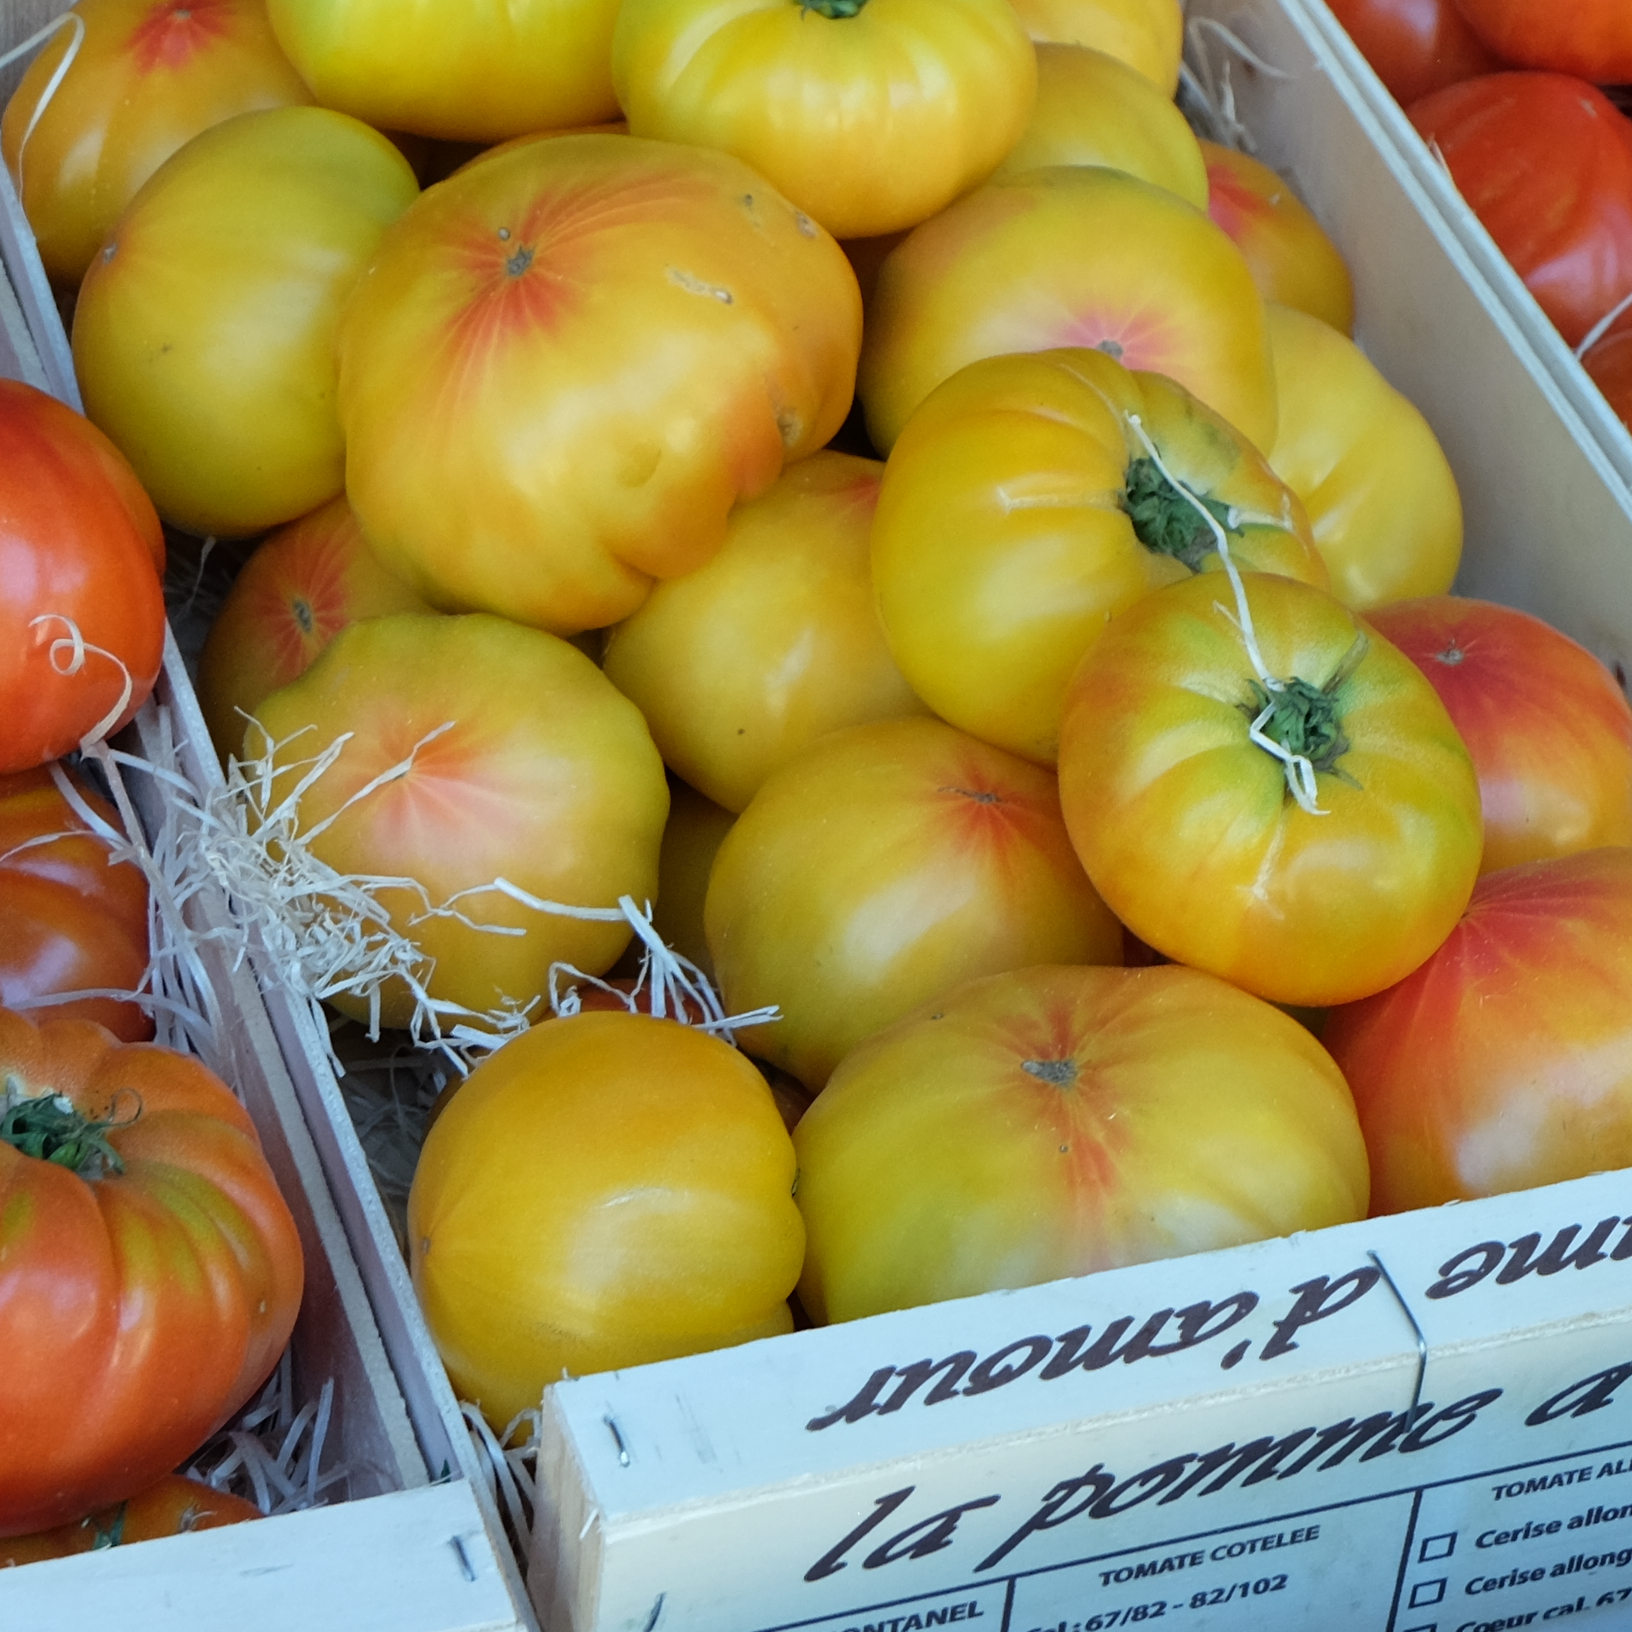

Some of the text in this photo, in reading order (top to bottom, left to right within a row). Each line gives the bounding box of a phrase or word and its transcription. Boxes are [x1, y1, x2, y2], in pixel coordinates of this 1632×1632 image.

[805, 1264, 1380, 1431] d'amour
[804, 1485, 1002, 1582] la
[972, 1388, 1503, 1573] pomme
[1491, 1466, 1593, 1501] TOMATE
[1475, 1521, 1562, 1549] Cerise
[1099, 1525, 1322, 1587] TOMATE COTELEE
[1189, 1574, 1289, 1610] 82/102
[1464, 1567, 1545, 1596] Cerise
